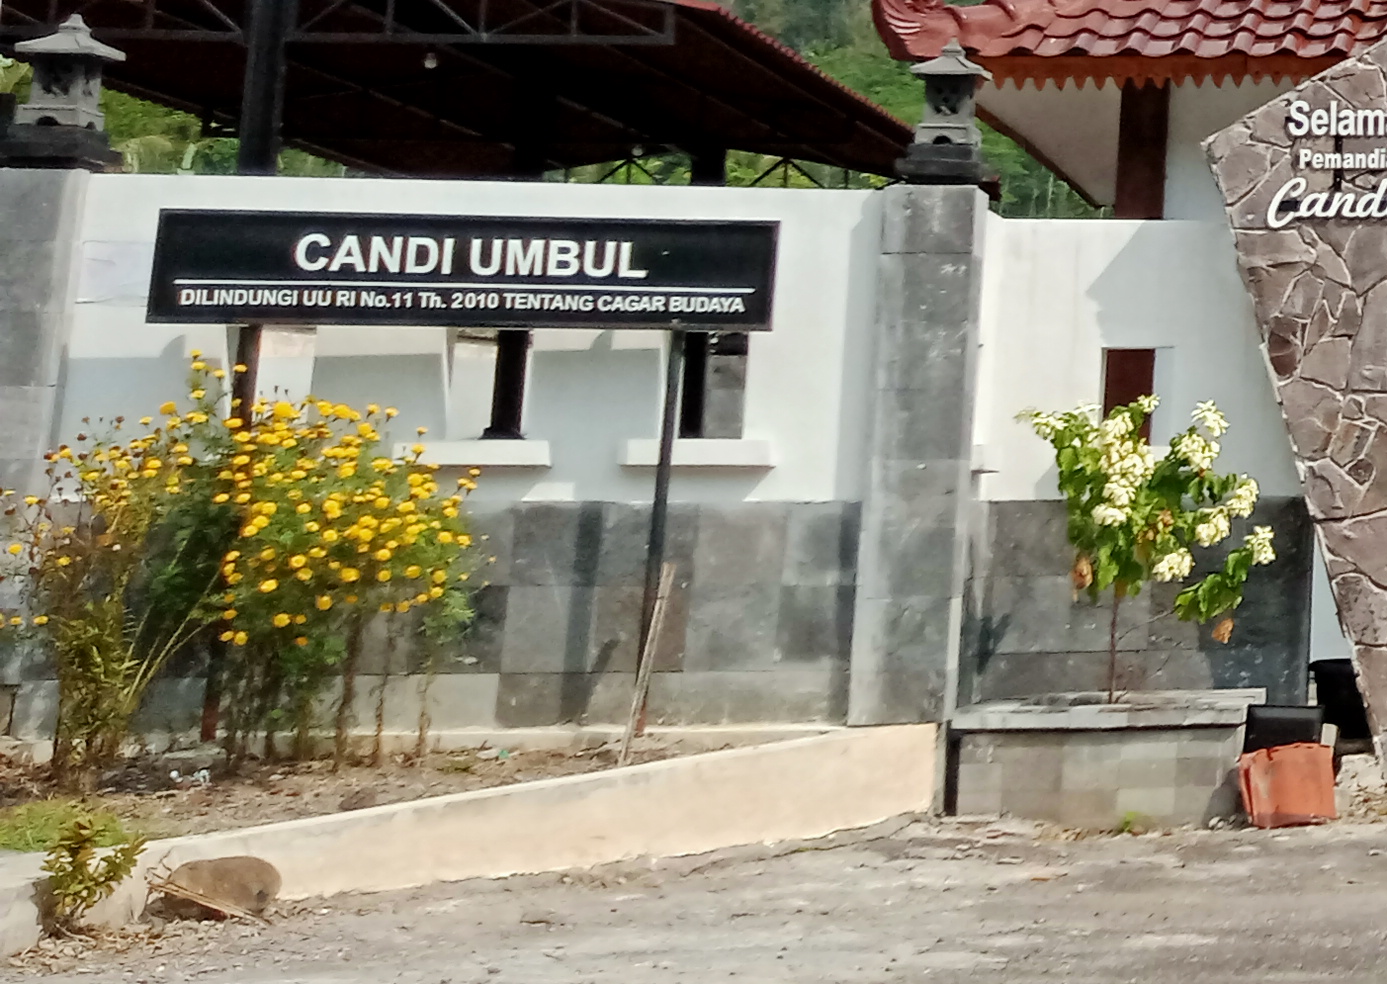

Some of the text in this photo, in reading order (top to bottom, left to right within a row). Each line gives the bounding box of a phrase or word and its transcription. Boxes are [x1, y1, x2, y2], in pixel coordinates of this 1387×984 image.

[295, 234, 647, 278] CANDI UMBUL
[181, 289, 744, 312] DILINDUNGI UU RI No.11 Th. 2010 TENTANG CAGAR BUDAYA
